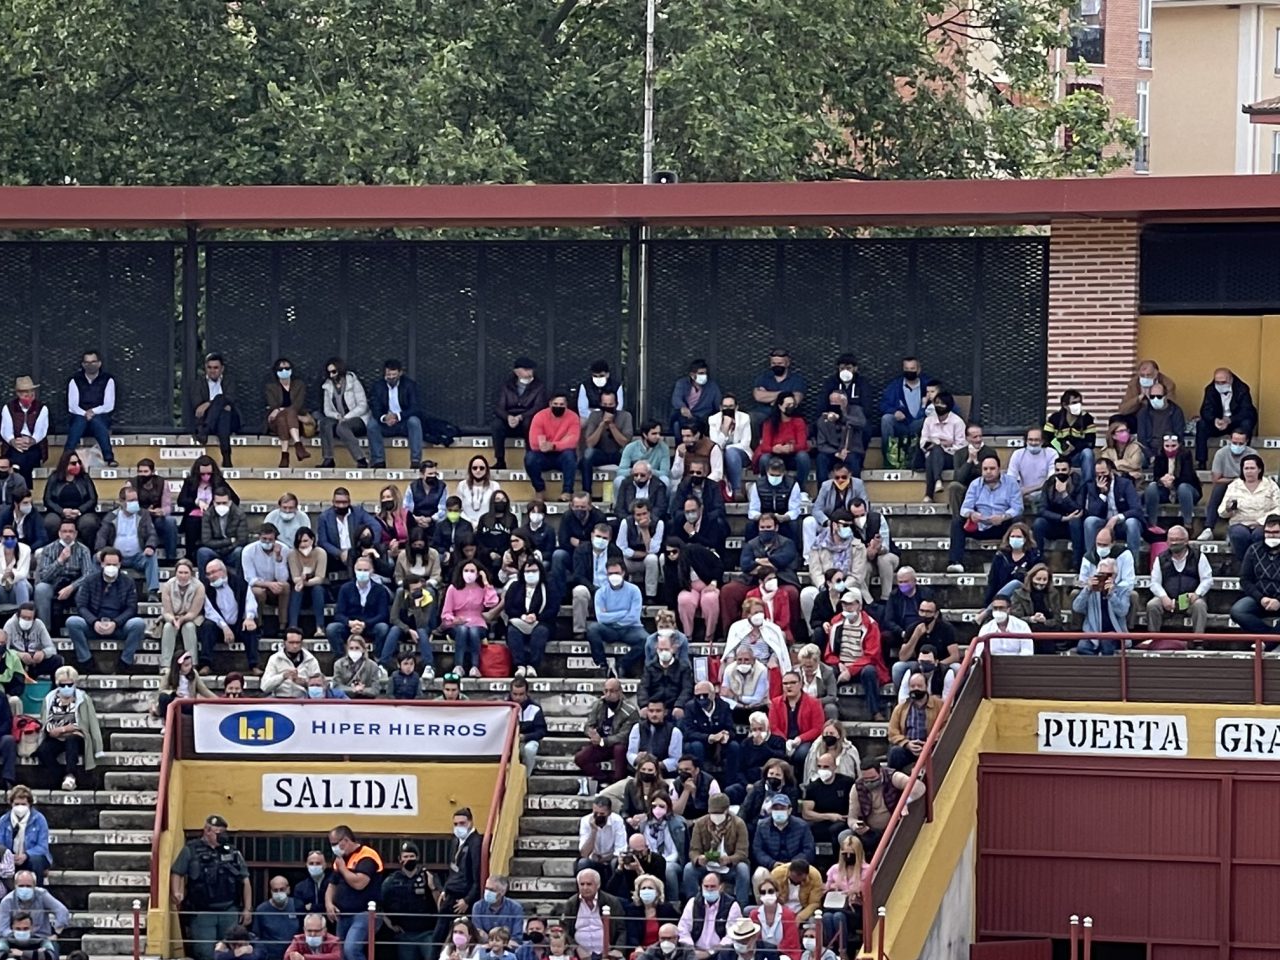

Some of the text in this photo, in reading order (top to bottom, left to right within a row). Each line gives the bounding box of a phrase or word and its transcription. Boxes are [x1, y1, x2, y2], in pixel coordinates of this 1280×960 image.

[312, 720, 487, 737] HIPER HIERROS
[1043, 718, 1183, 751] PUERTA
[273, 776, 413, 810] SALIDA
